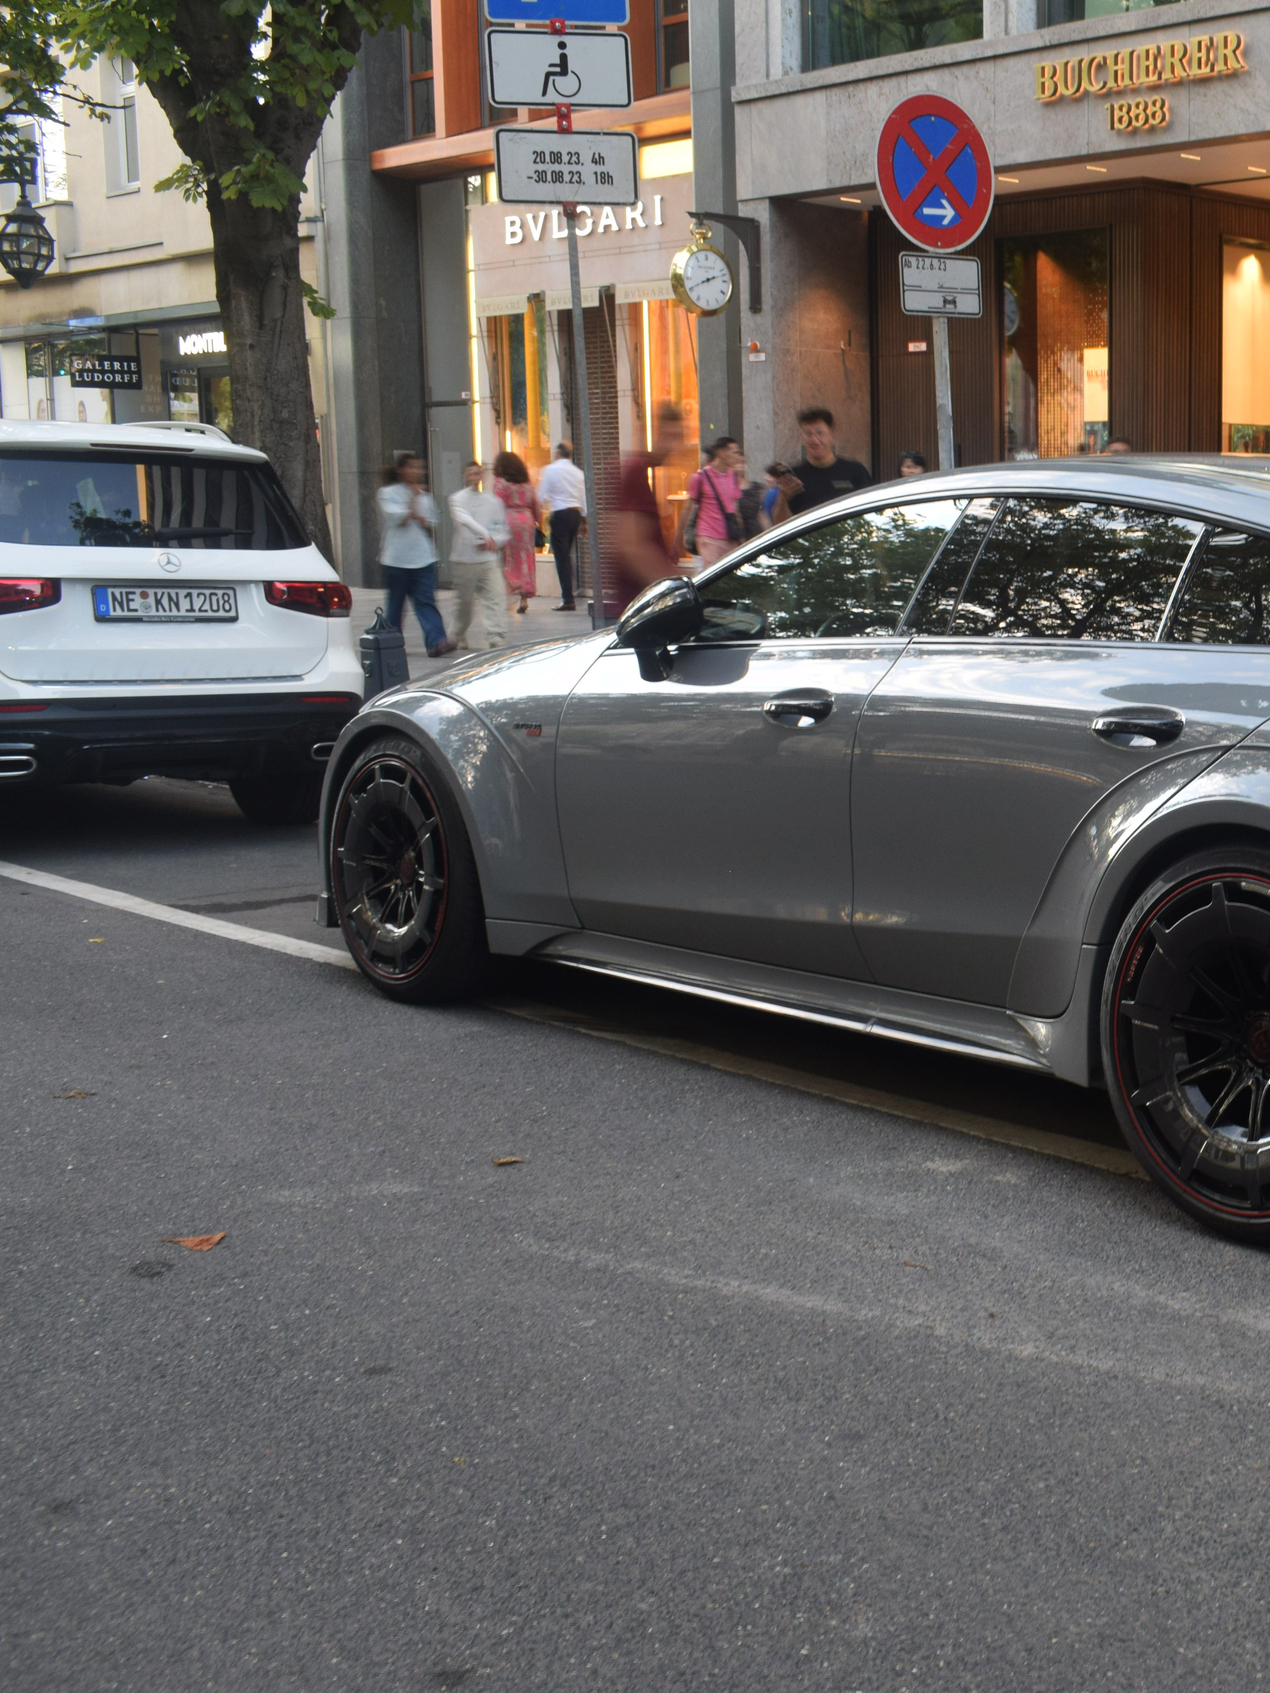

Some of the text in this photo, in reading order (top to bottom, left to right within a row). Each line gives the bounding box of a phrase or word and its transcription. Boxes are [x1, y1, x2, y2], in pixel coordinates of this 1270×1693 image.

[1034, 31, 1248, 100] BUCHERER
[1105, 96, 1169, 130] 1888
[532, 150, 606, 166] 20.08.23, 4h
[526, 169, 614, 186] -30.08.23, 18h
[505, 194, 663, 245] BVLGARI
[903, 257, 948, 272] Ab 22.6.23
[74, 360, 138, 372] GALERIE
[75, 372, 139, 383] LUDORFF
[110, 590, 233, 614] NE KN 1208
